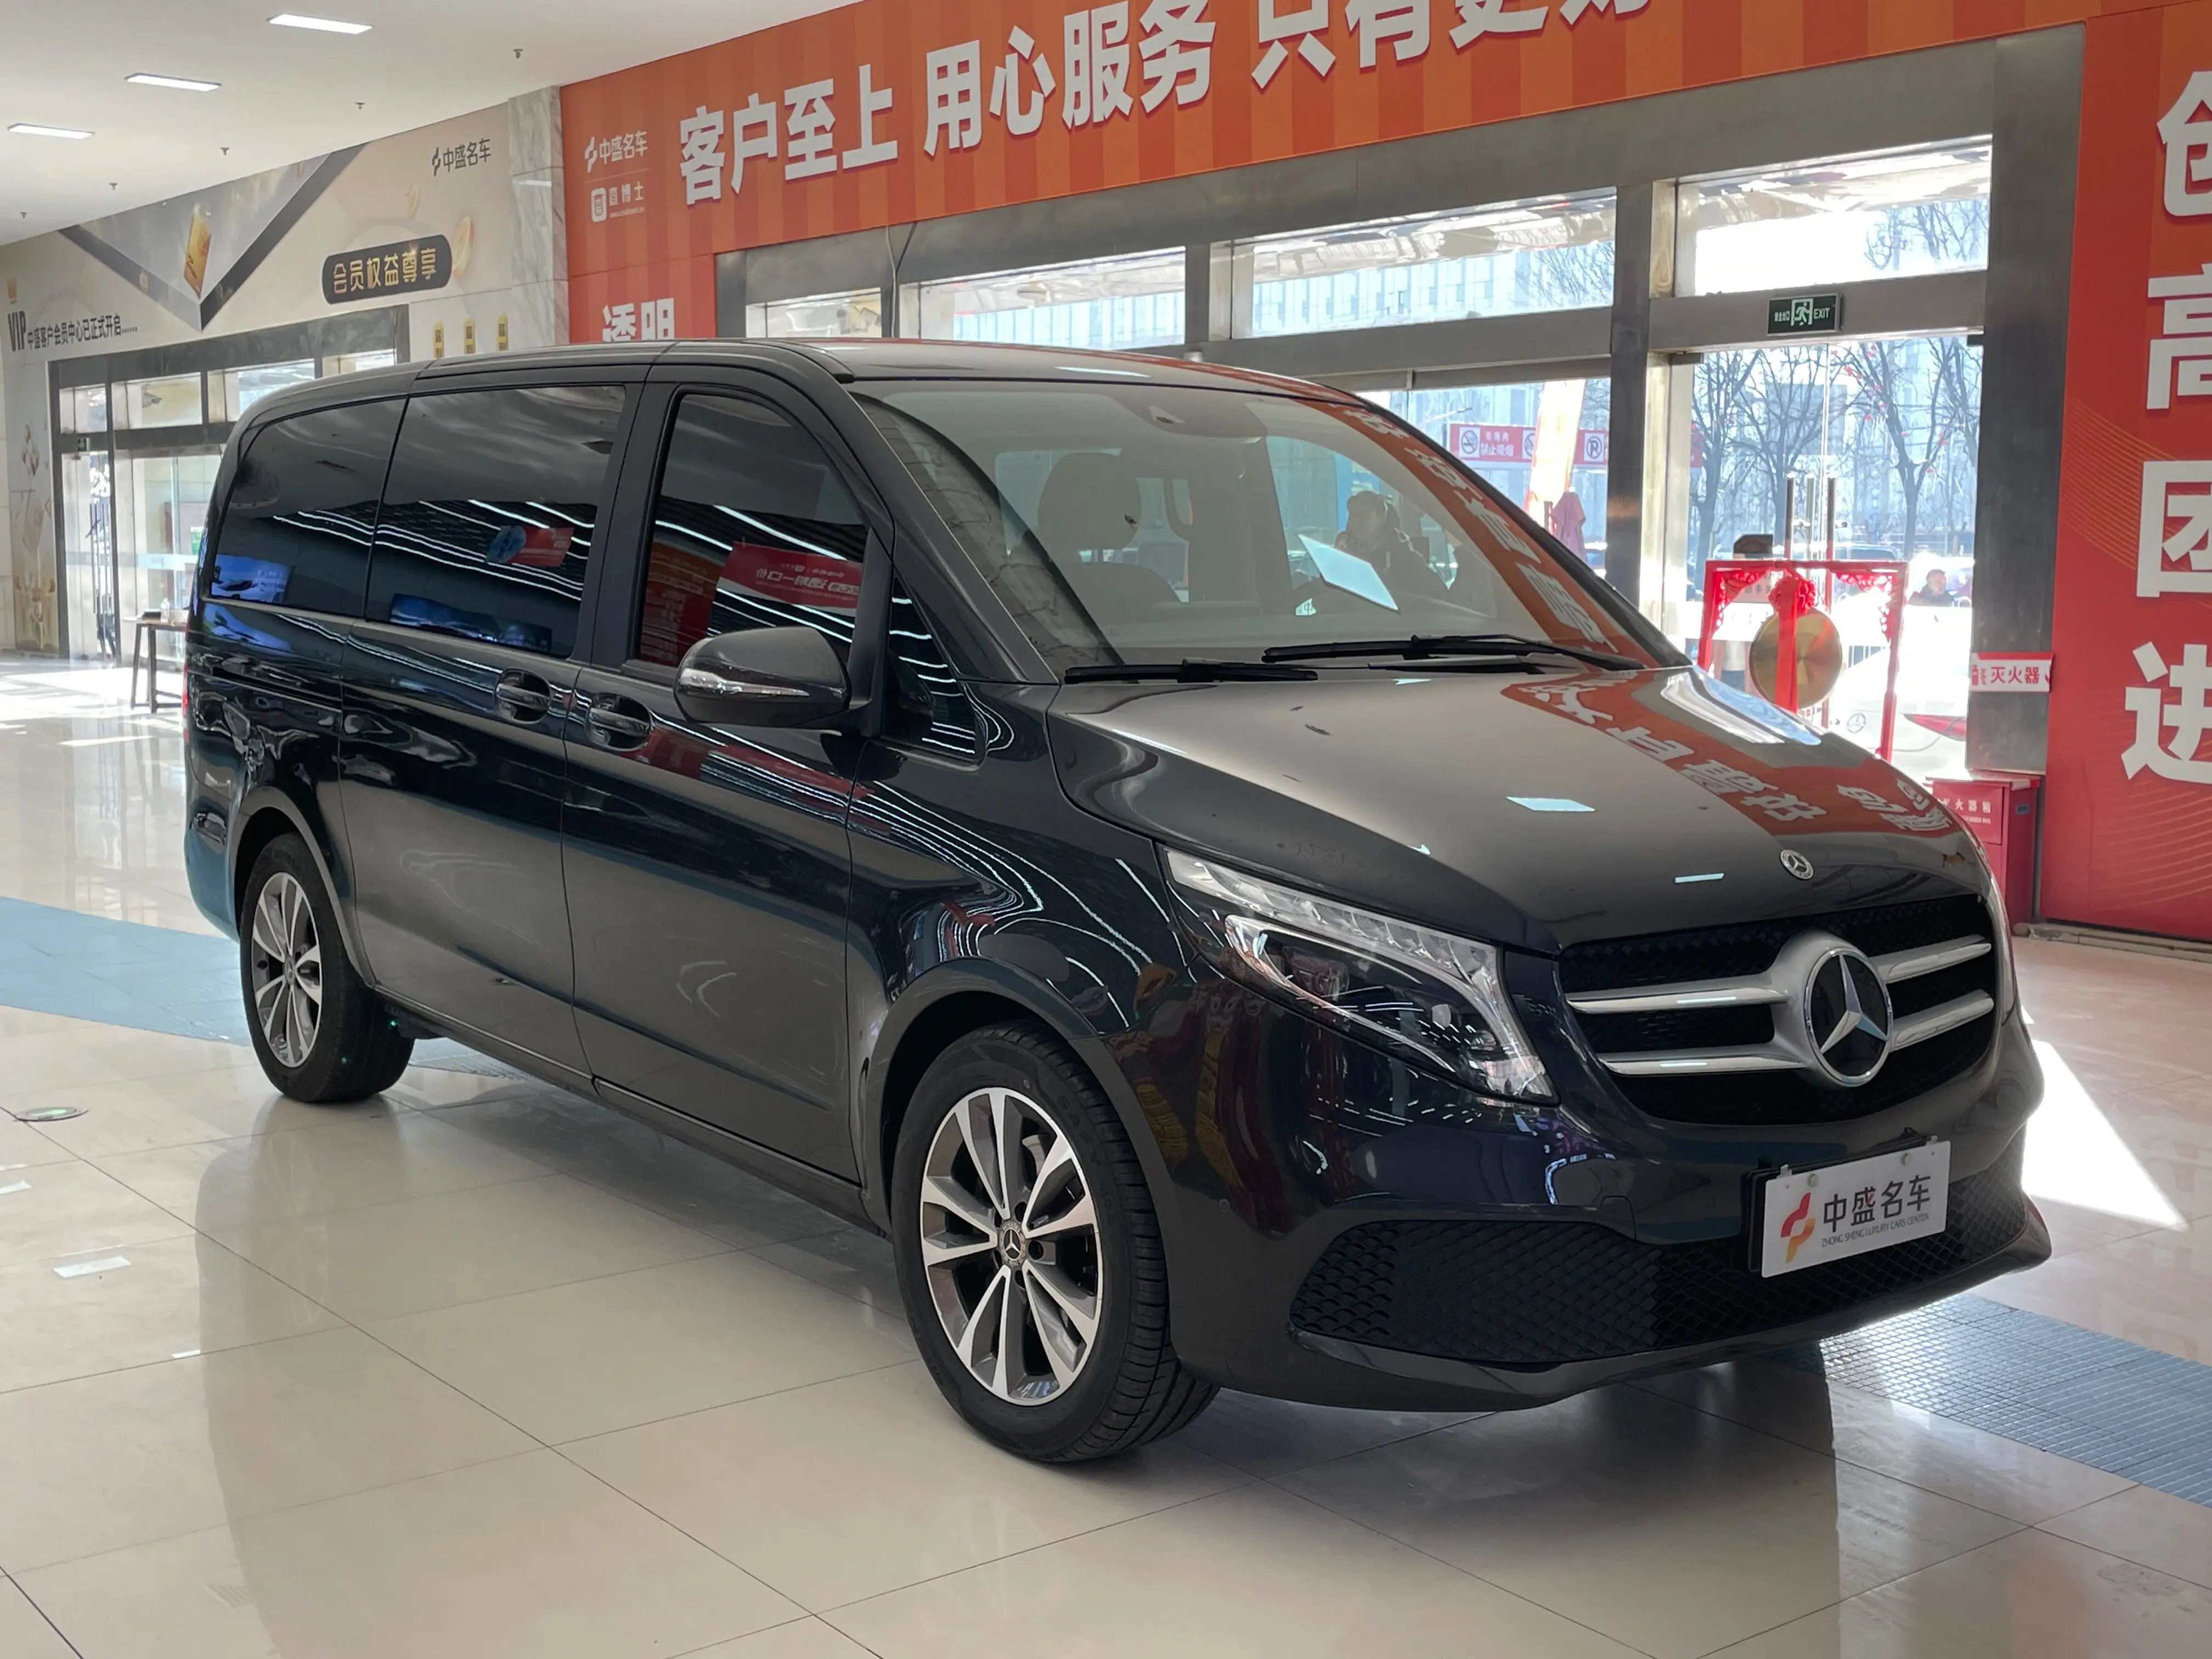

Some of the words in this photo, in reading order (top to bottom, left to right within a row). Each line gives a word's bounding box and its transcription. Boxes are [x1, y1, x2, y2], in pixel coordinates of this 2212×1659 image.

[680, 64, 898, 205] 客户至上
[924, 0, 1216, 156] 用心服务
[443, 138, 492, 172] 中盛名车
[599, 130, 648, 165] 中盛名车
[333, 248, 437, 294] 会员权益尊享
[1814, 307, 1830, 319] EXIT
[8, 311, 26, 352] VIP
[1990, 665, 2040, 684] 灭火器
[1824, 1175, 1931, 1232] 中盛名车
[1890, 1218, 1906, 1230] CARS
